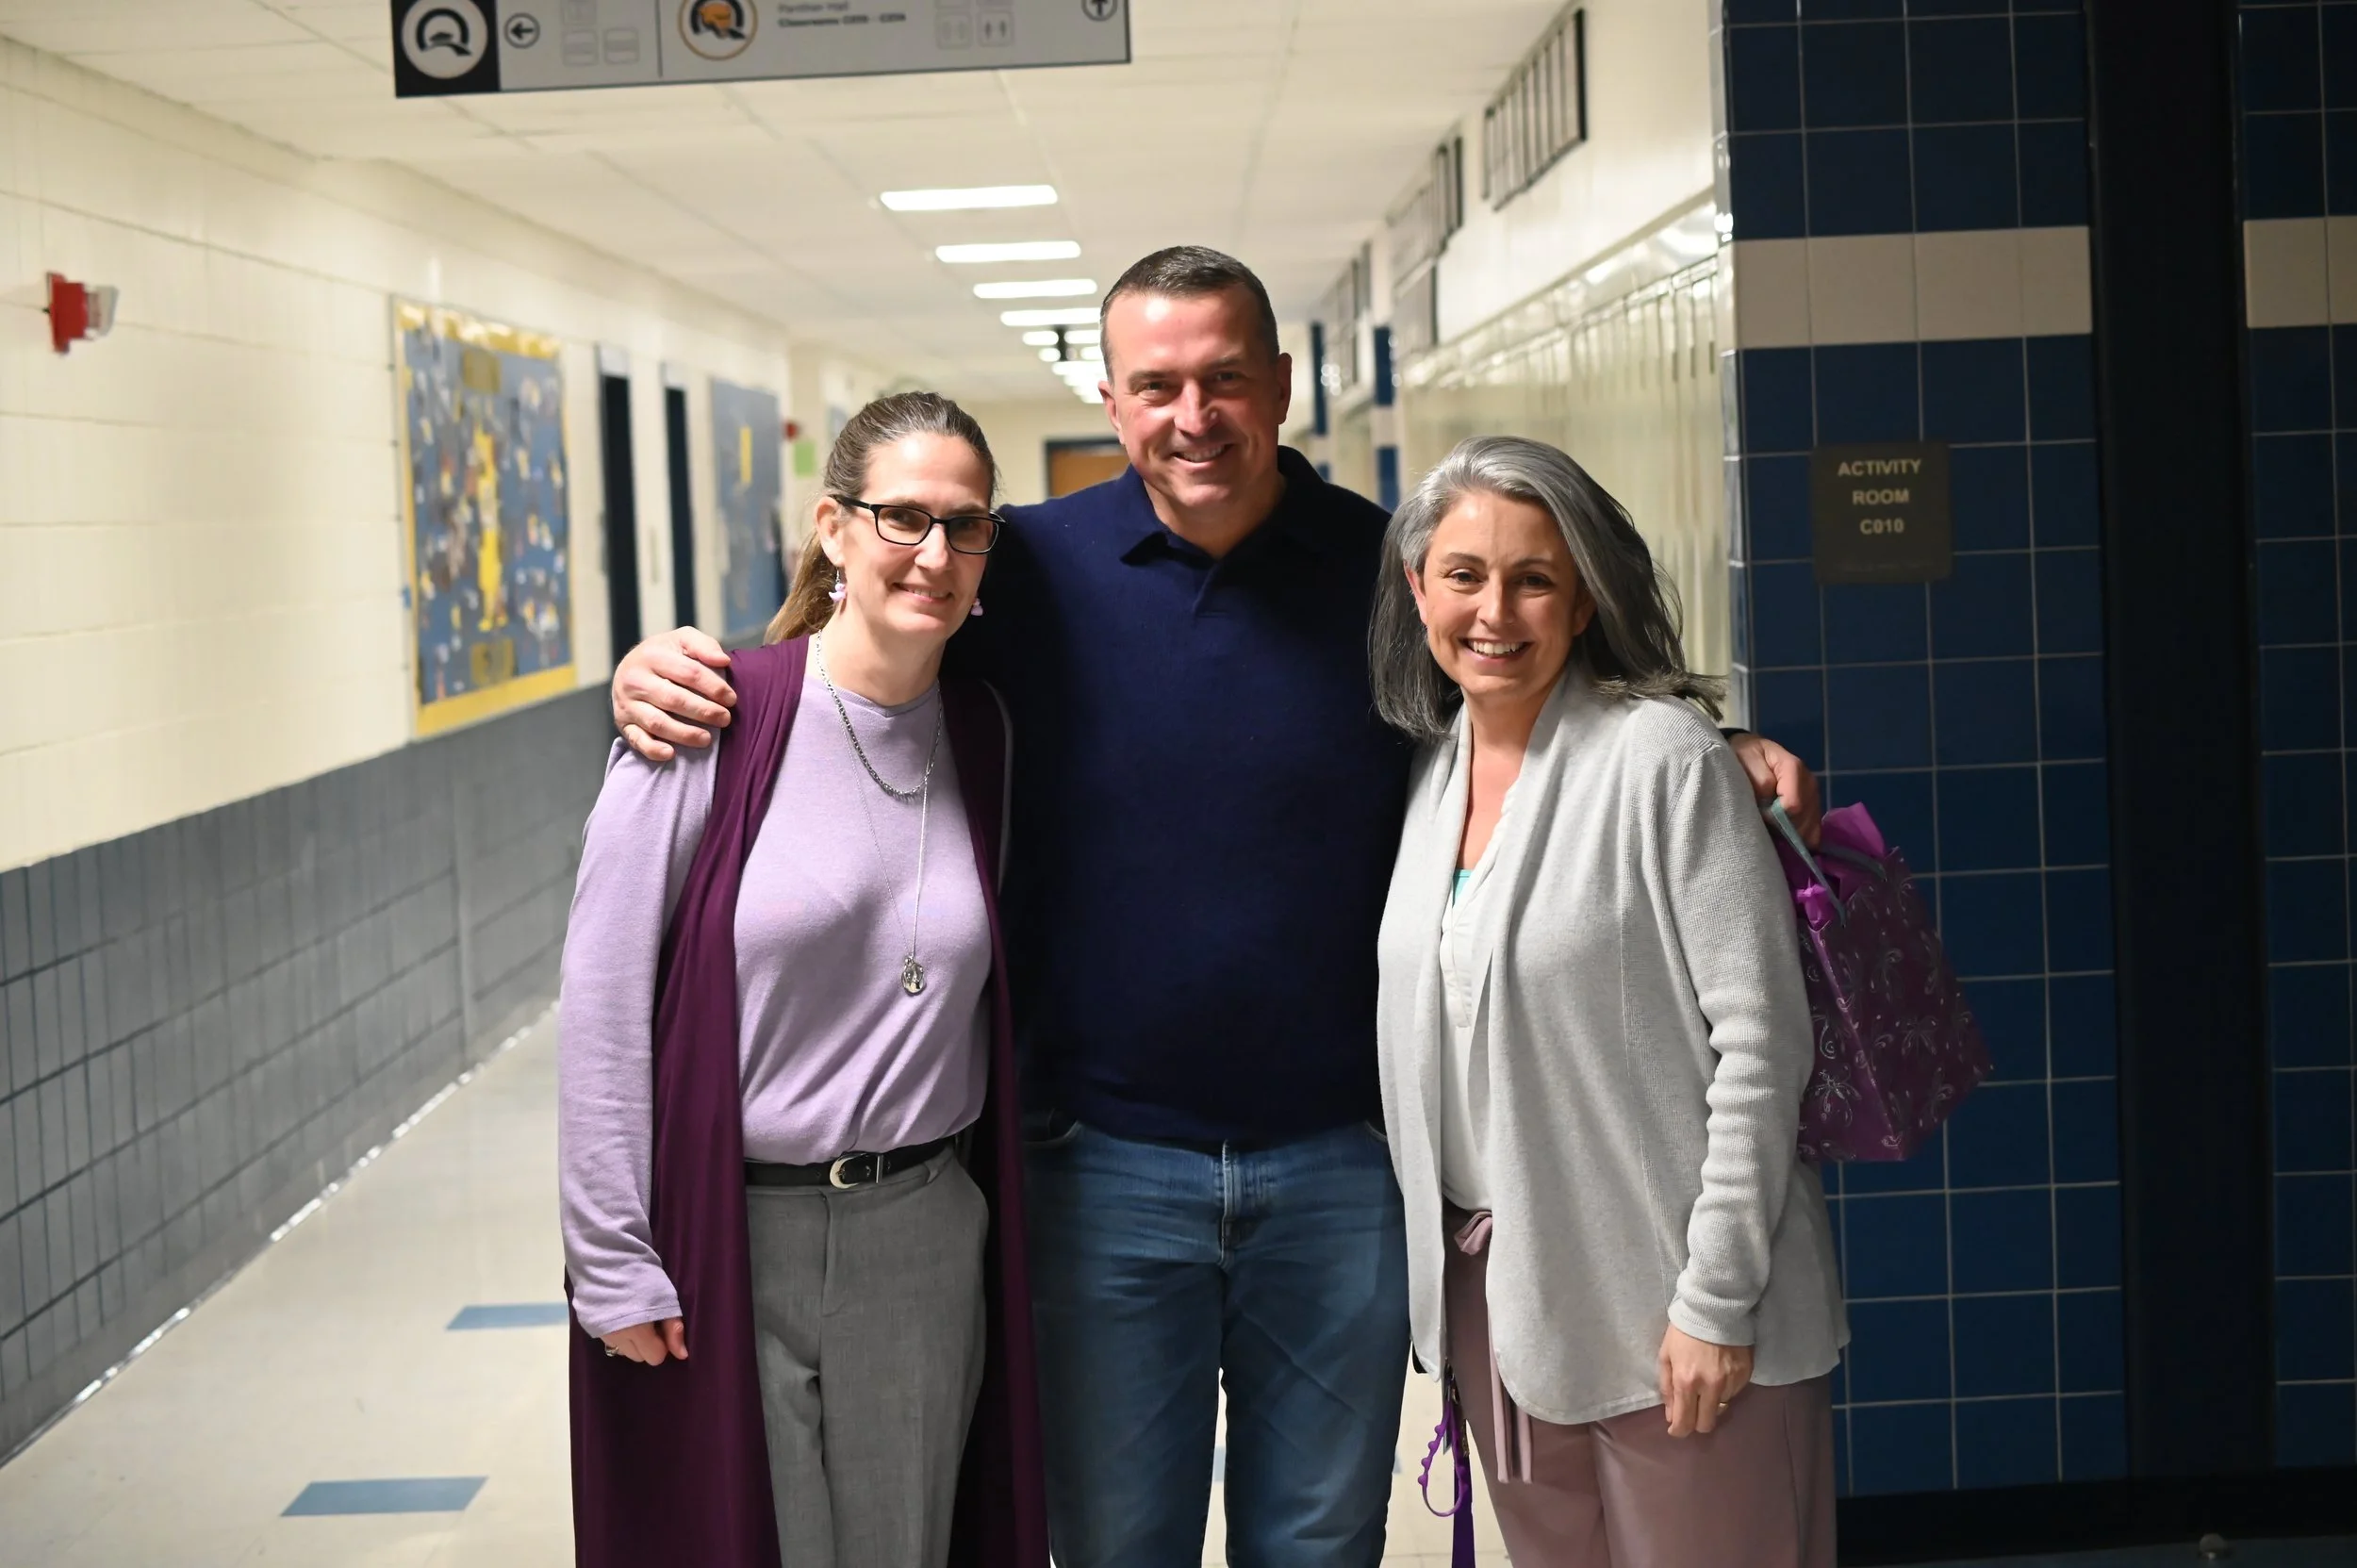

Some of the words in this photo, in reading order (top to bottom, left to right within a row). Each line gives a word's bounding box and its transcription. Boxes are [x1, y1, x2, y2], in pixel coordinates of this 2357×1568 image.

[1838, 459, 1921, 476] ACTIVITY
[1853, 488, 1909, 504] ROOM
[1860, 518, 1904, 535] C010
